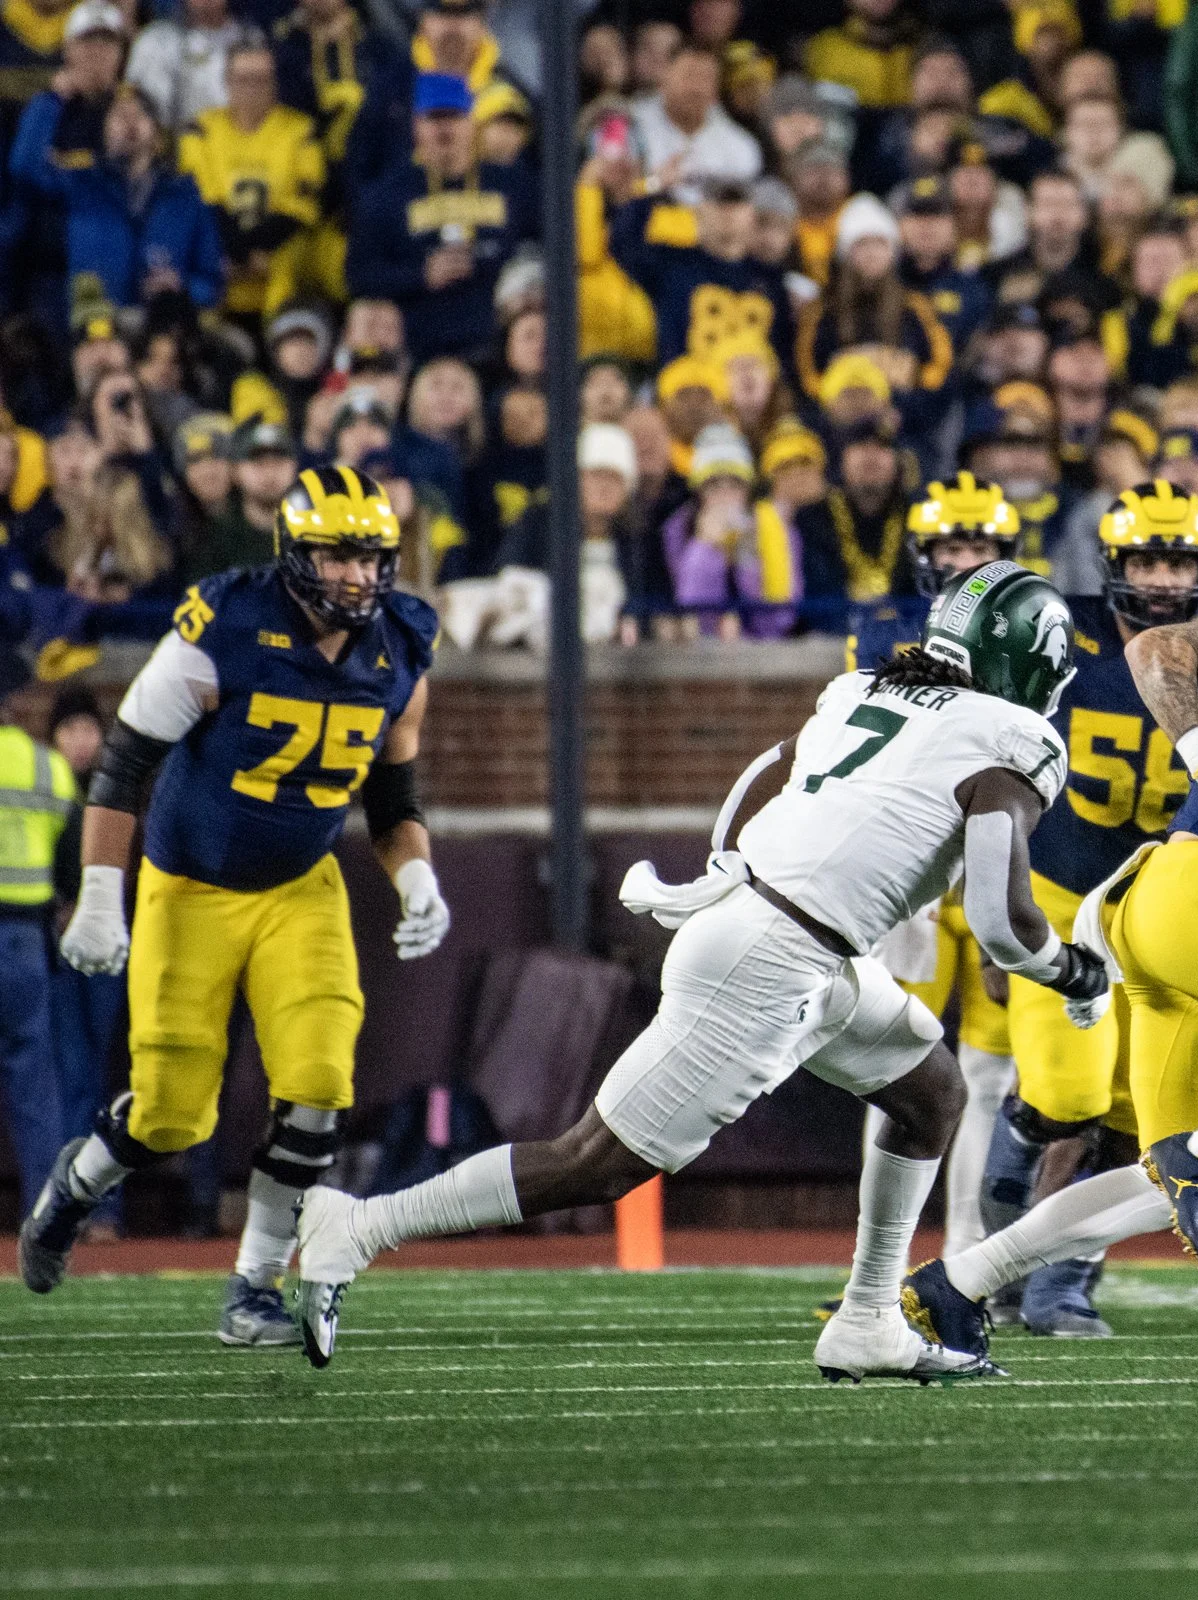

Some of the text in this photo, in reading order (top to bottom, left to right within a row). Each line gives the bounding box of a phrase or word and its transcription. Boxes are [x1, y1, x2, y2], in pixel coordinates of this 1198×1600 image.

[231, 691, 386, 808] 75
[802, 703, 909, 794] 7
[1027, 736, 1062, 779] 7
